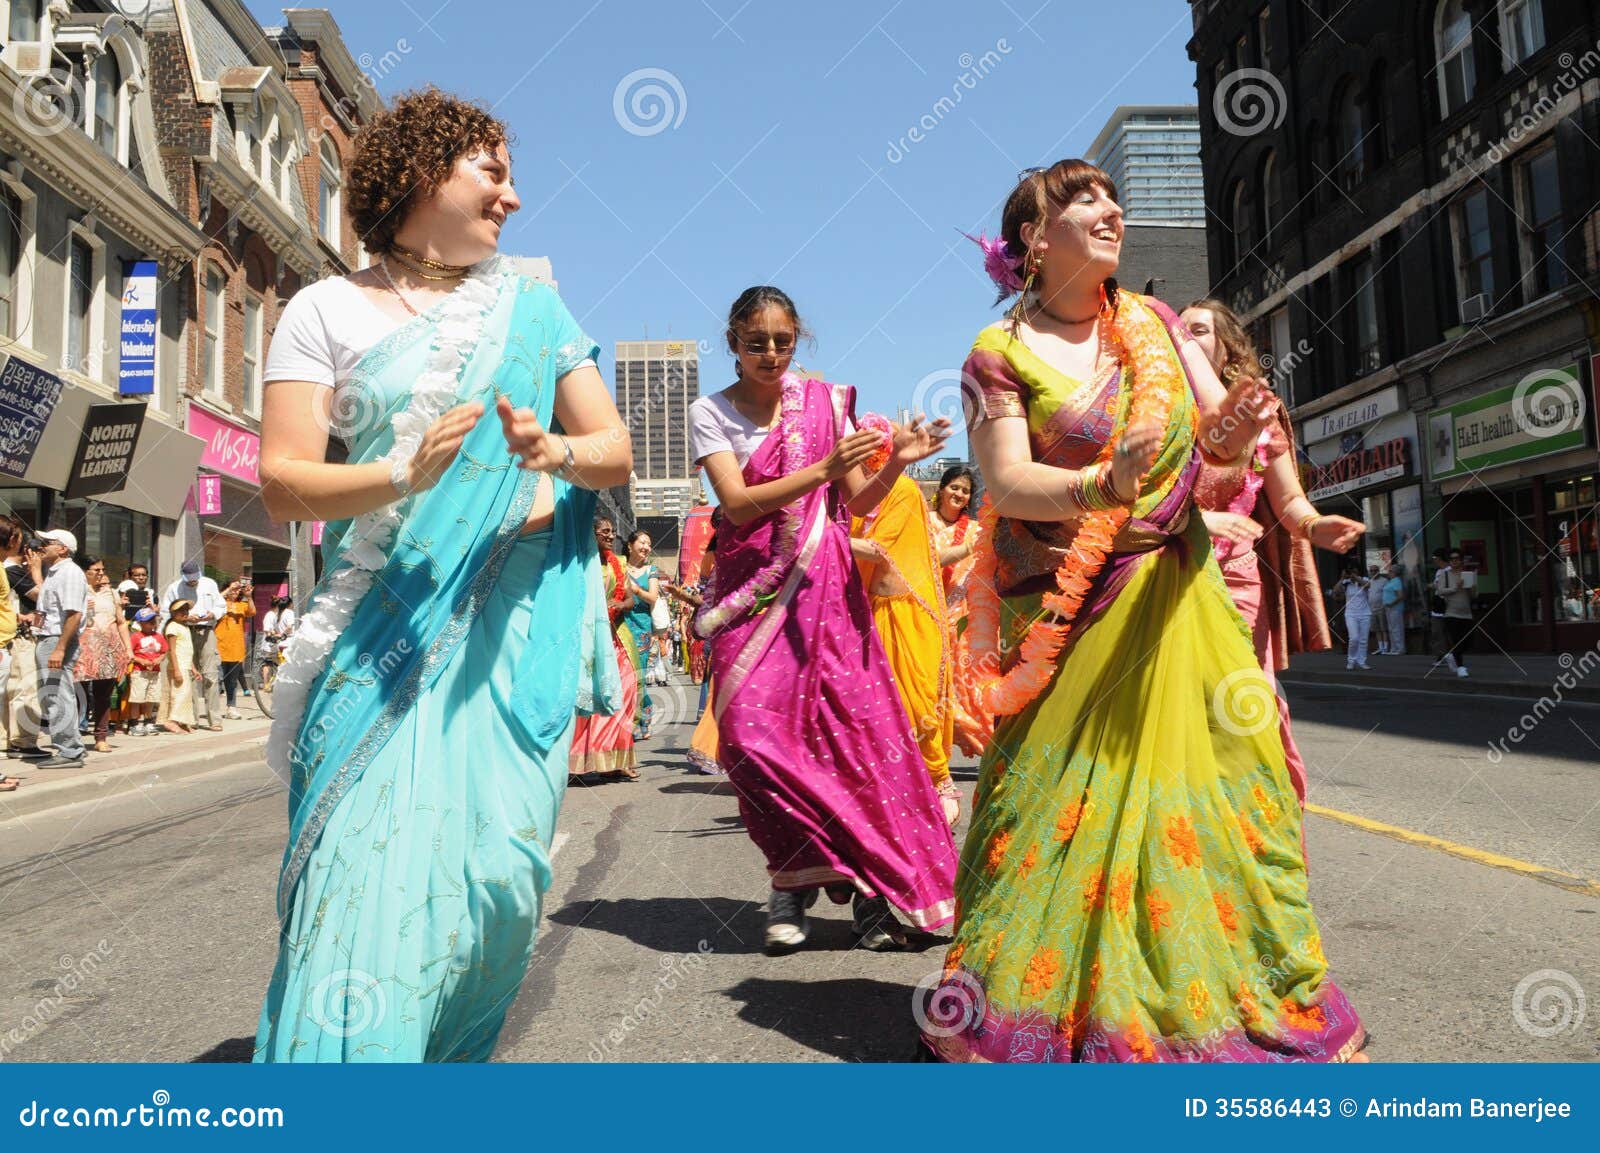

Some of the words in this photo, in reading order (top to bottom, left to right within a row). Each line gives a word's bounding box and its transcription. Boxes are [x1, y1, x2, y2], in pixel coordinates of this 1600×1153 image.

[121, 320, 154, 337] Internship
[121, 341, 154, 356] Volunteer
[90, 423, 137, 443] NORTH
[1482, 414, 1514, 442] health
[84, 441, 132, 461] BOUND
[79, 457, 128, 479] LEATHER
[1304, 437, 1407, 491] TRAVELAIR
[205, 478, 215, 511] HAIR
